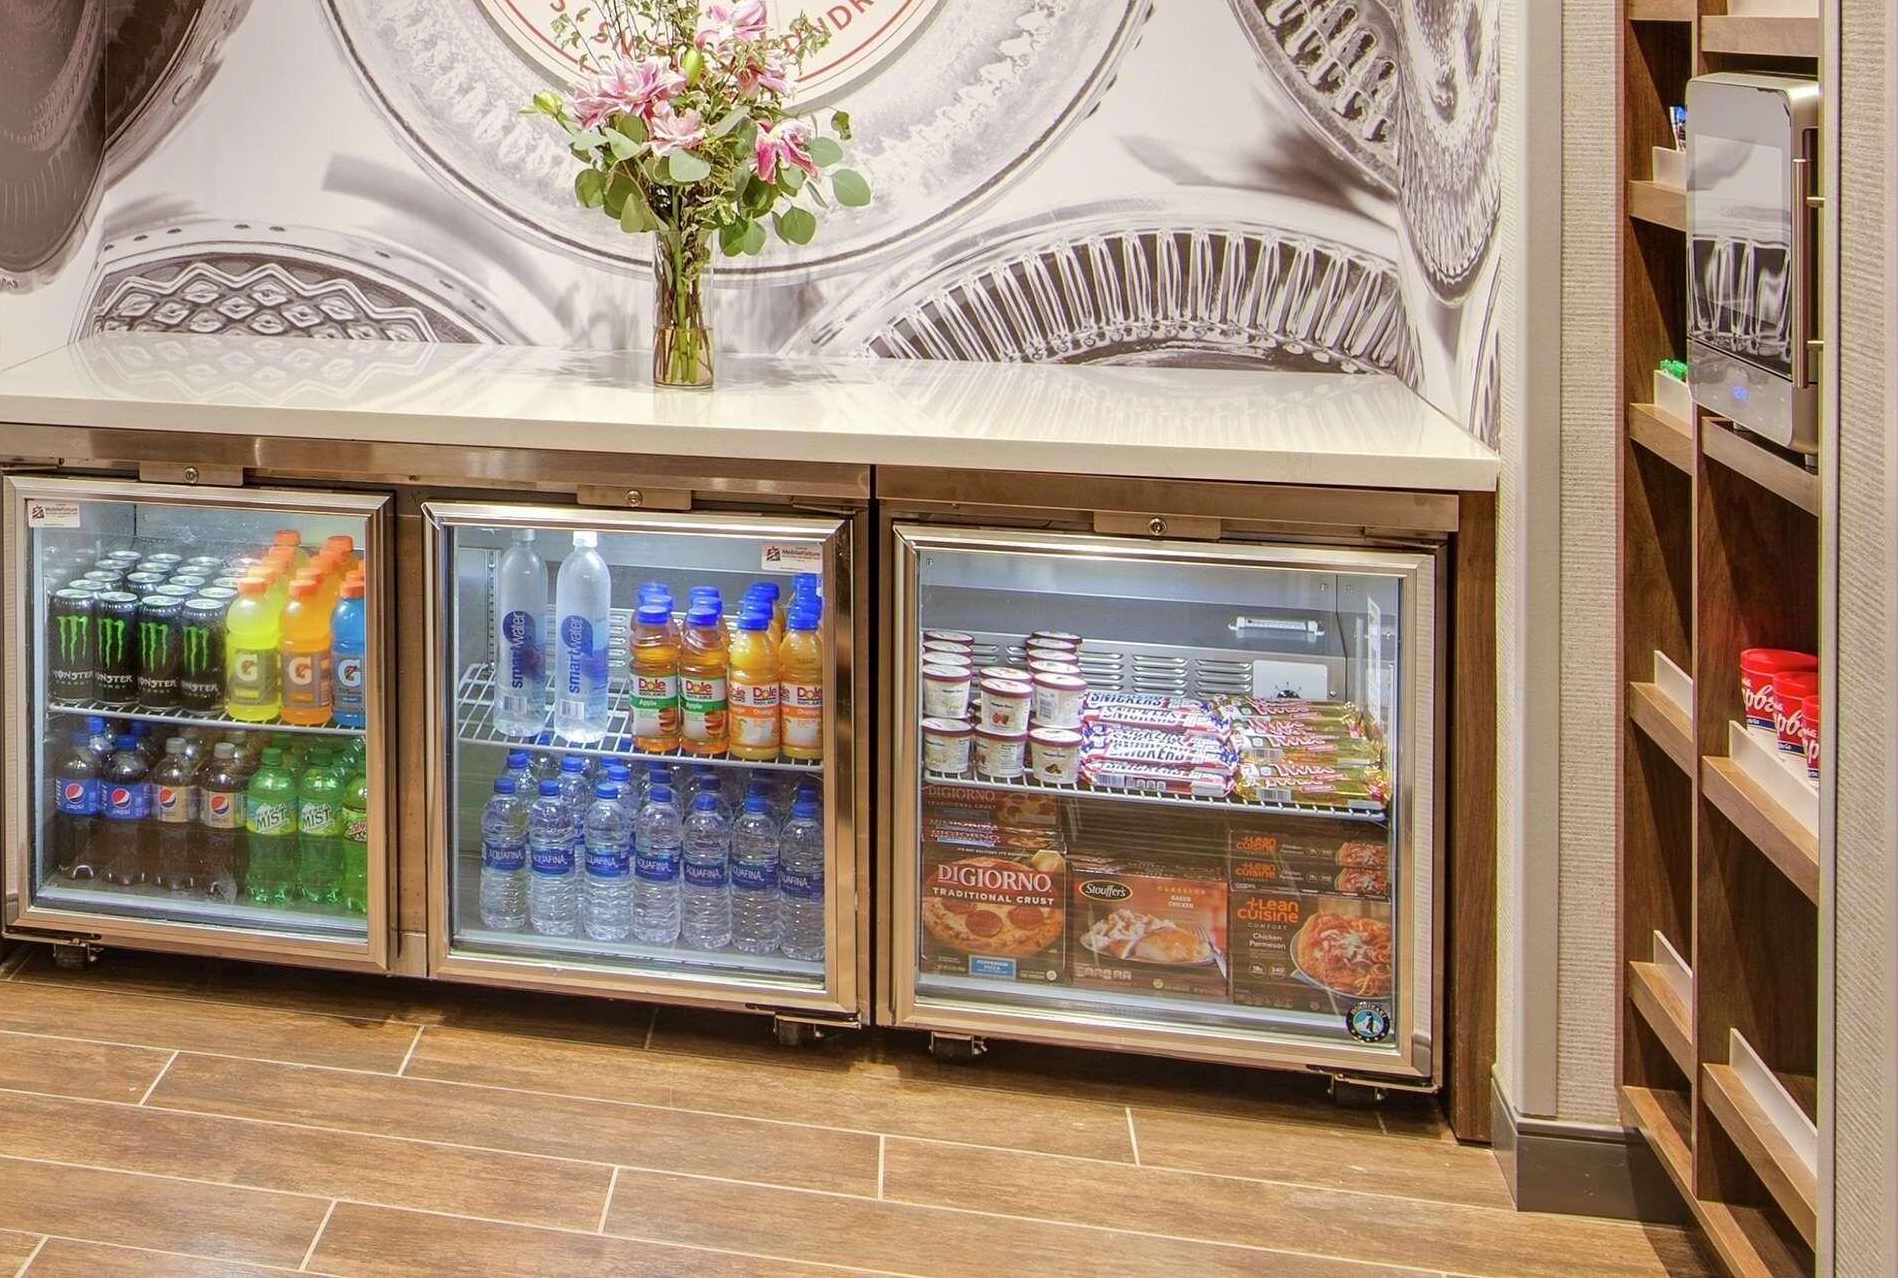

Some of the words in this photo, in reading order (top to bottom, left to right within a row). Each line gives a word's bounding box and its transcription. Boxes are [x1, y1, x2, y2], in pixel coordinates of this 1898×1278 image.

[511, 611, 524, 689] smartwater
[568, 615, 583, 694] smartwater
[235, 653, 258, 682] G
[288, 656, 313, 685] G
[338, 659, 361, 688] G
[638, 677, 667, 691] Dole
[685, 680, 712, 693] Dole
[753, 685, 777, 699] Dole
[256, 808, 287, 834] MIST
[489, 848, 524, 860] AQUAFINA
[686, 865, 722, 879] AQUAFINA
[932, 886, 1012, 904] TRADITIONAL
[1016, 896, 1054, 906] CRUST
[1085, 883, 1127, 897] Stouffer's
[1247, 922, 1288, 931] COMFORT
[1252, 932, 1283, 941] Chicken
[1248, 939, 1287, 951] Parmesan
